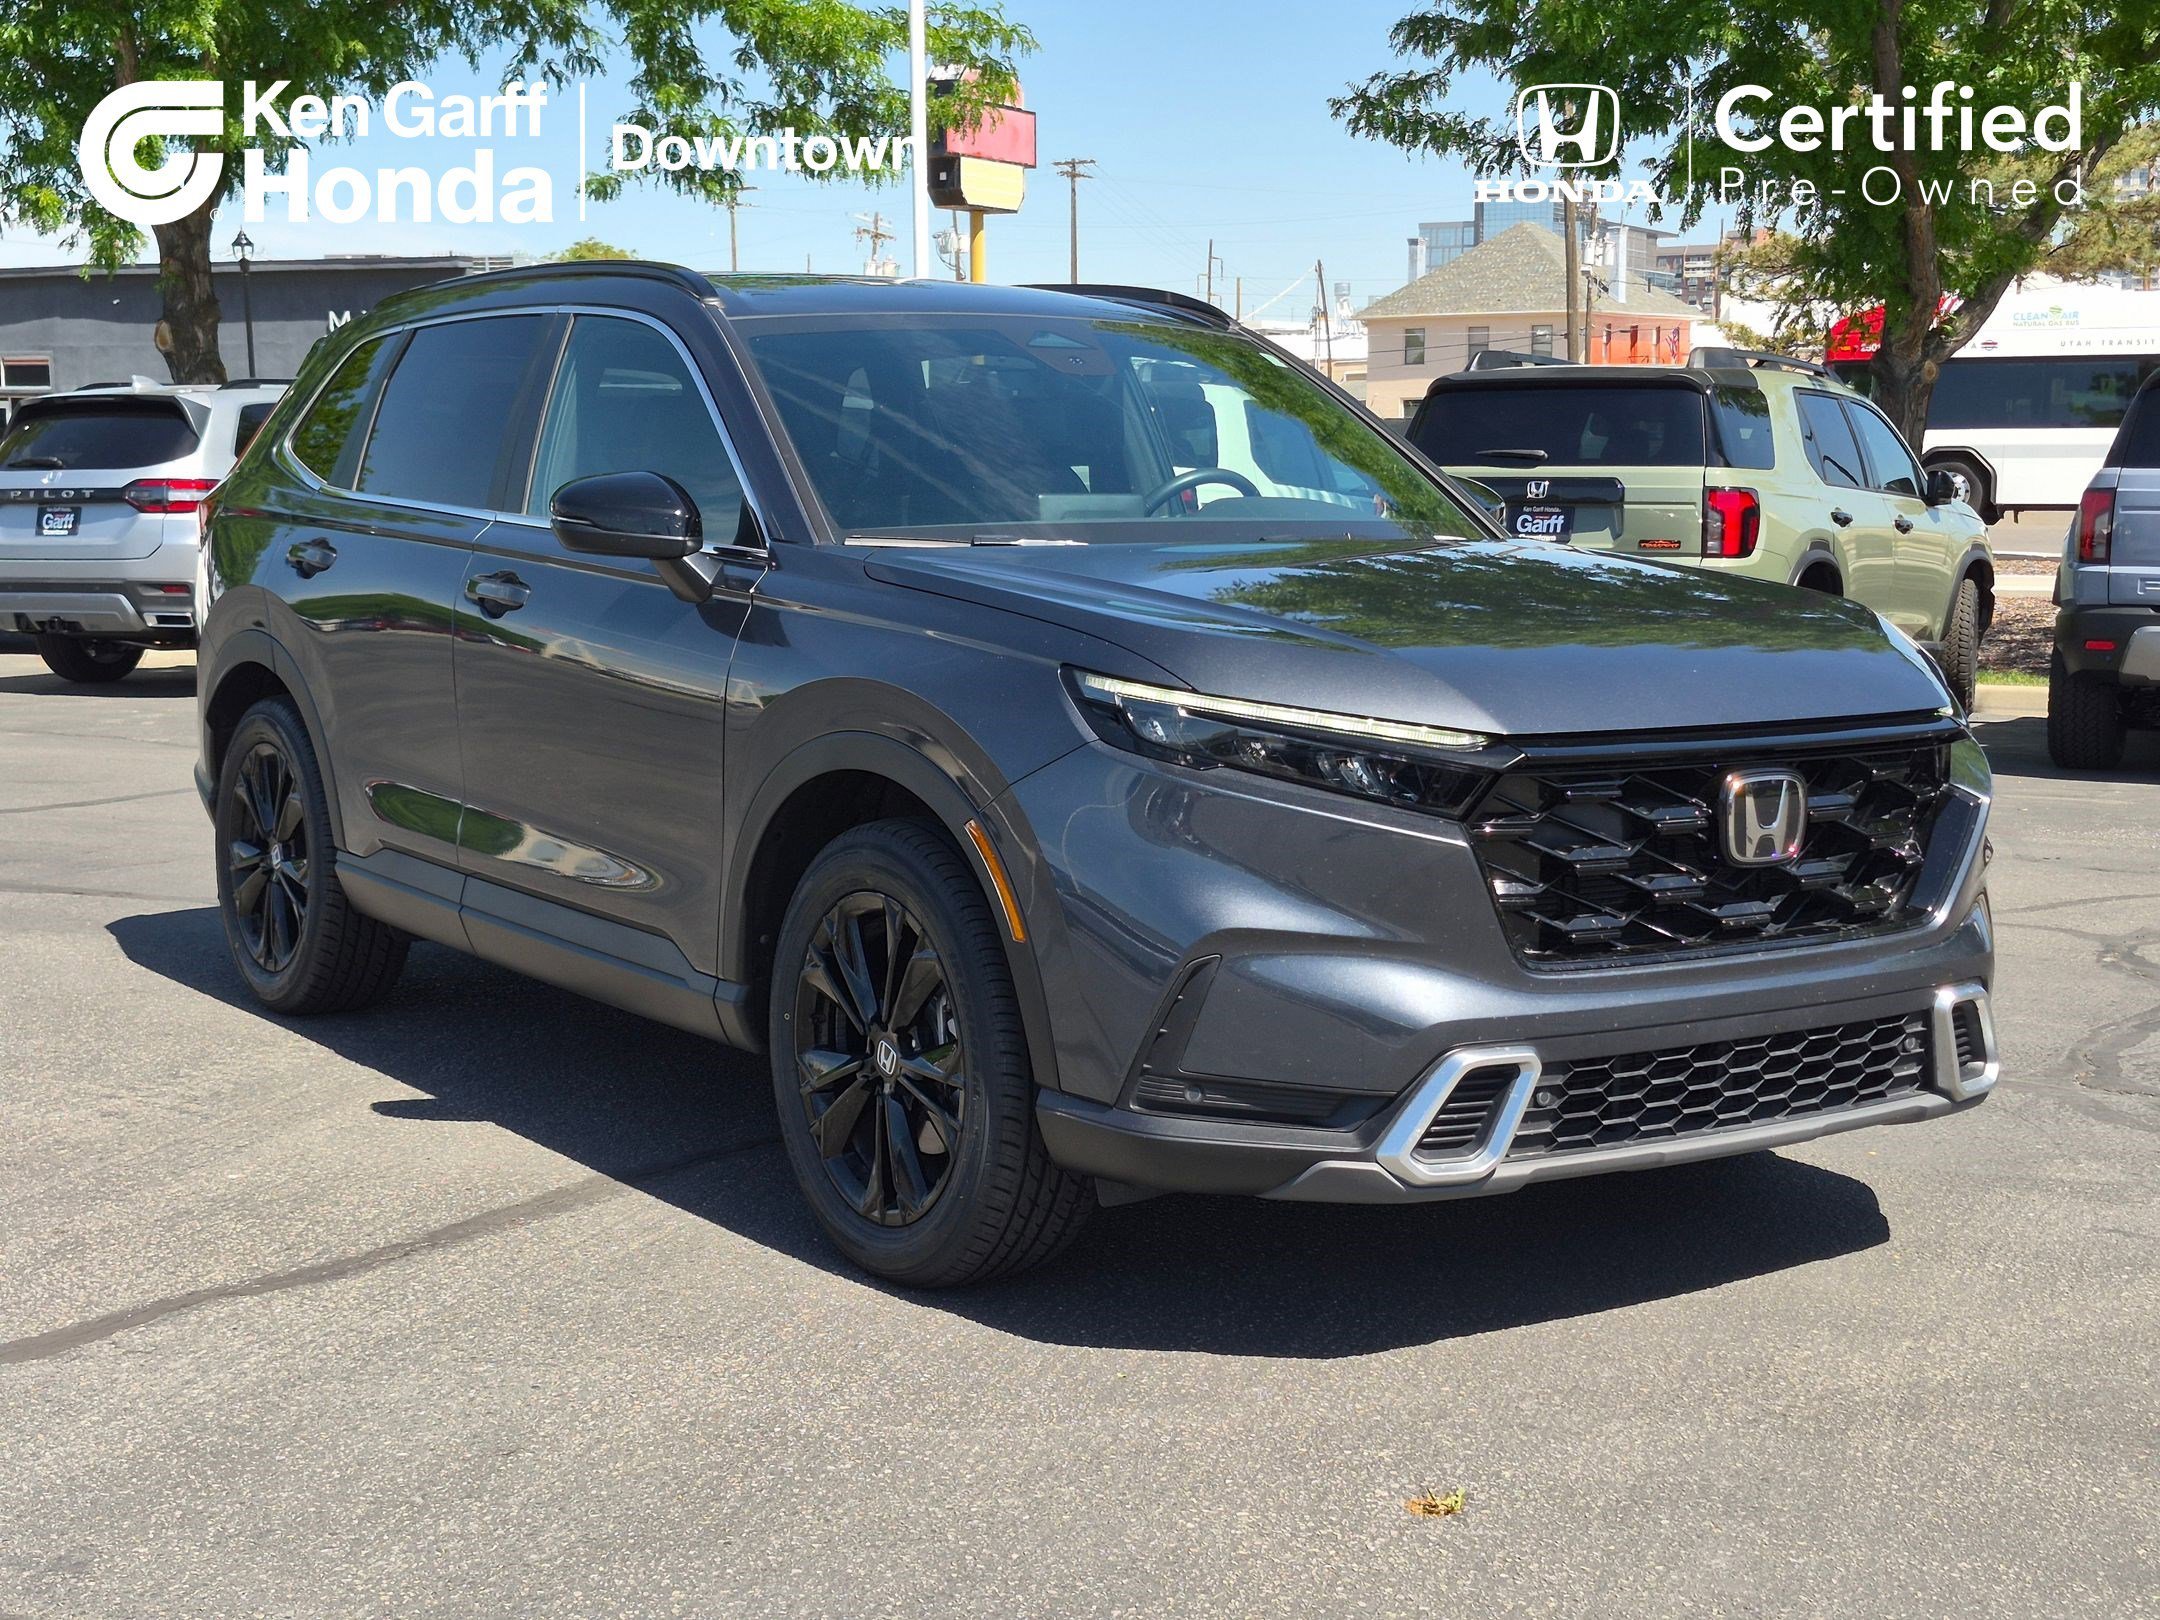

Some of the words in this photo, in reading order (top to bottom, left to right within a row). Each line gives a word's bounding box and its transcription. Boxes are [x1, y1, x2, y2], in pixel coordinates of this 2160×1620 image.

[2013, 312, 2048, 321] CLEAN
[2061, 311, 2080, 320] AIR
[2102, 338, 2155, 346] TRANSIT
[10, 490, 95, 499] PILOT
[42, 513, 74, 529] Garff
[1516, 514, 1564, 533] Garff
